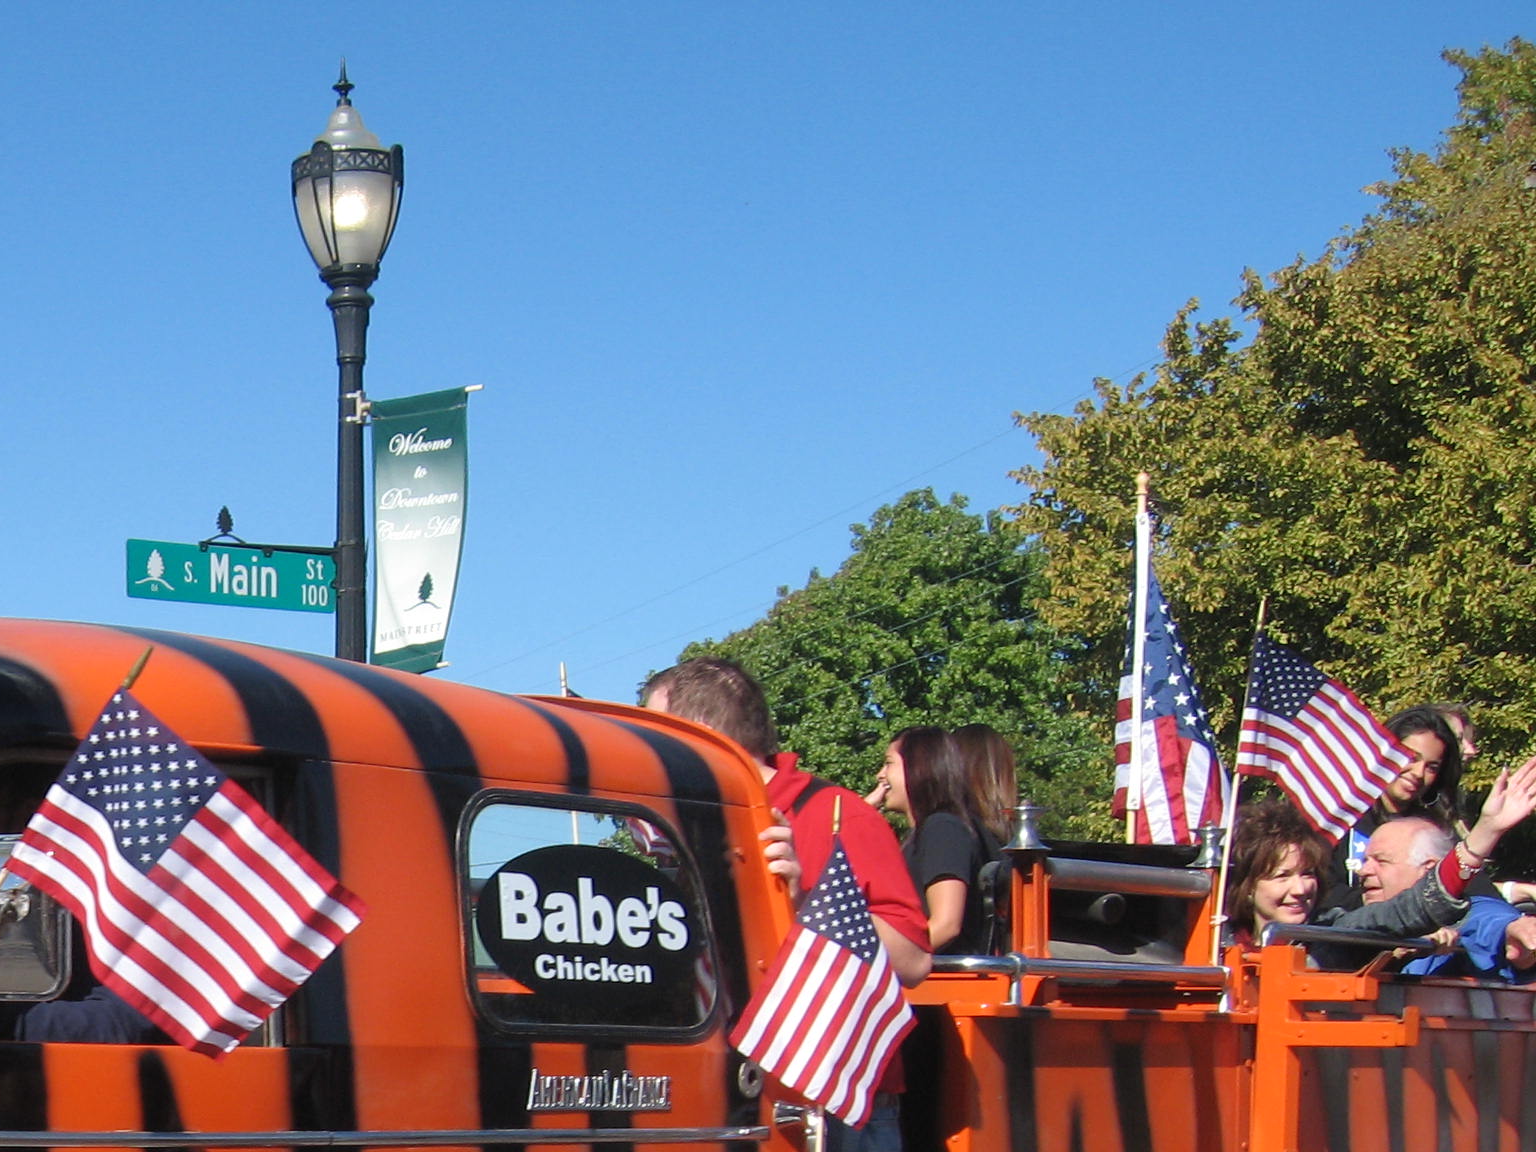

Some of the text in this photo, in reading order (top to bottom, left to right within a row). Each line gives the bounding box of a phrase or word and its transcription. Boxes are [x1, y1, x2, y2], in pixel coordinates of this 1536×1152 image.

[388, 427, 453, 456] Welcome
[413, 465, 428, 479] to
[379, 487, 459, 510] Downtown
[377, 515, 461, 541] Cedar Hill
[184, 552, 324, 598] S. Main St
[301, 584, 328, 606] 100
[498, 872, 688, 951] Babe's
[534, 954, 652, 983] Chicken
